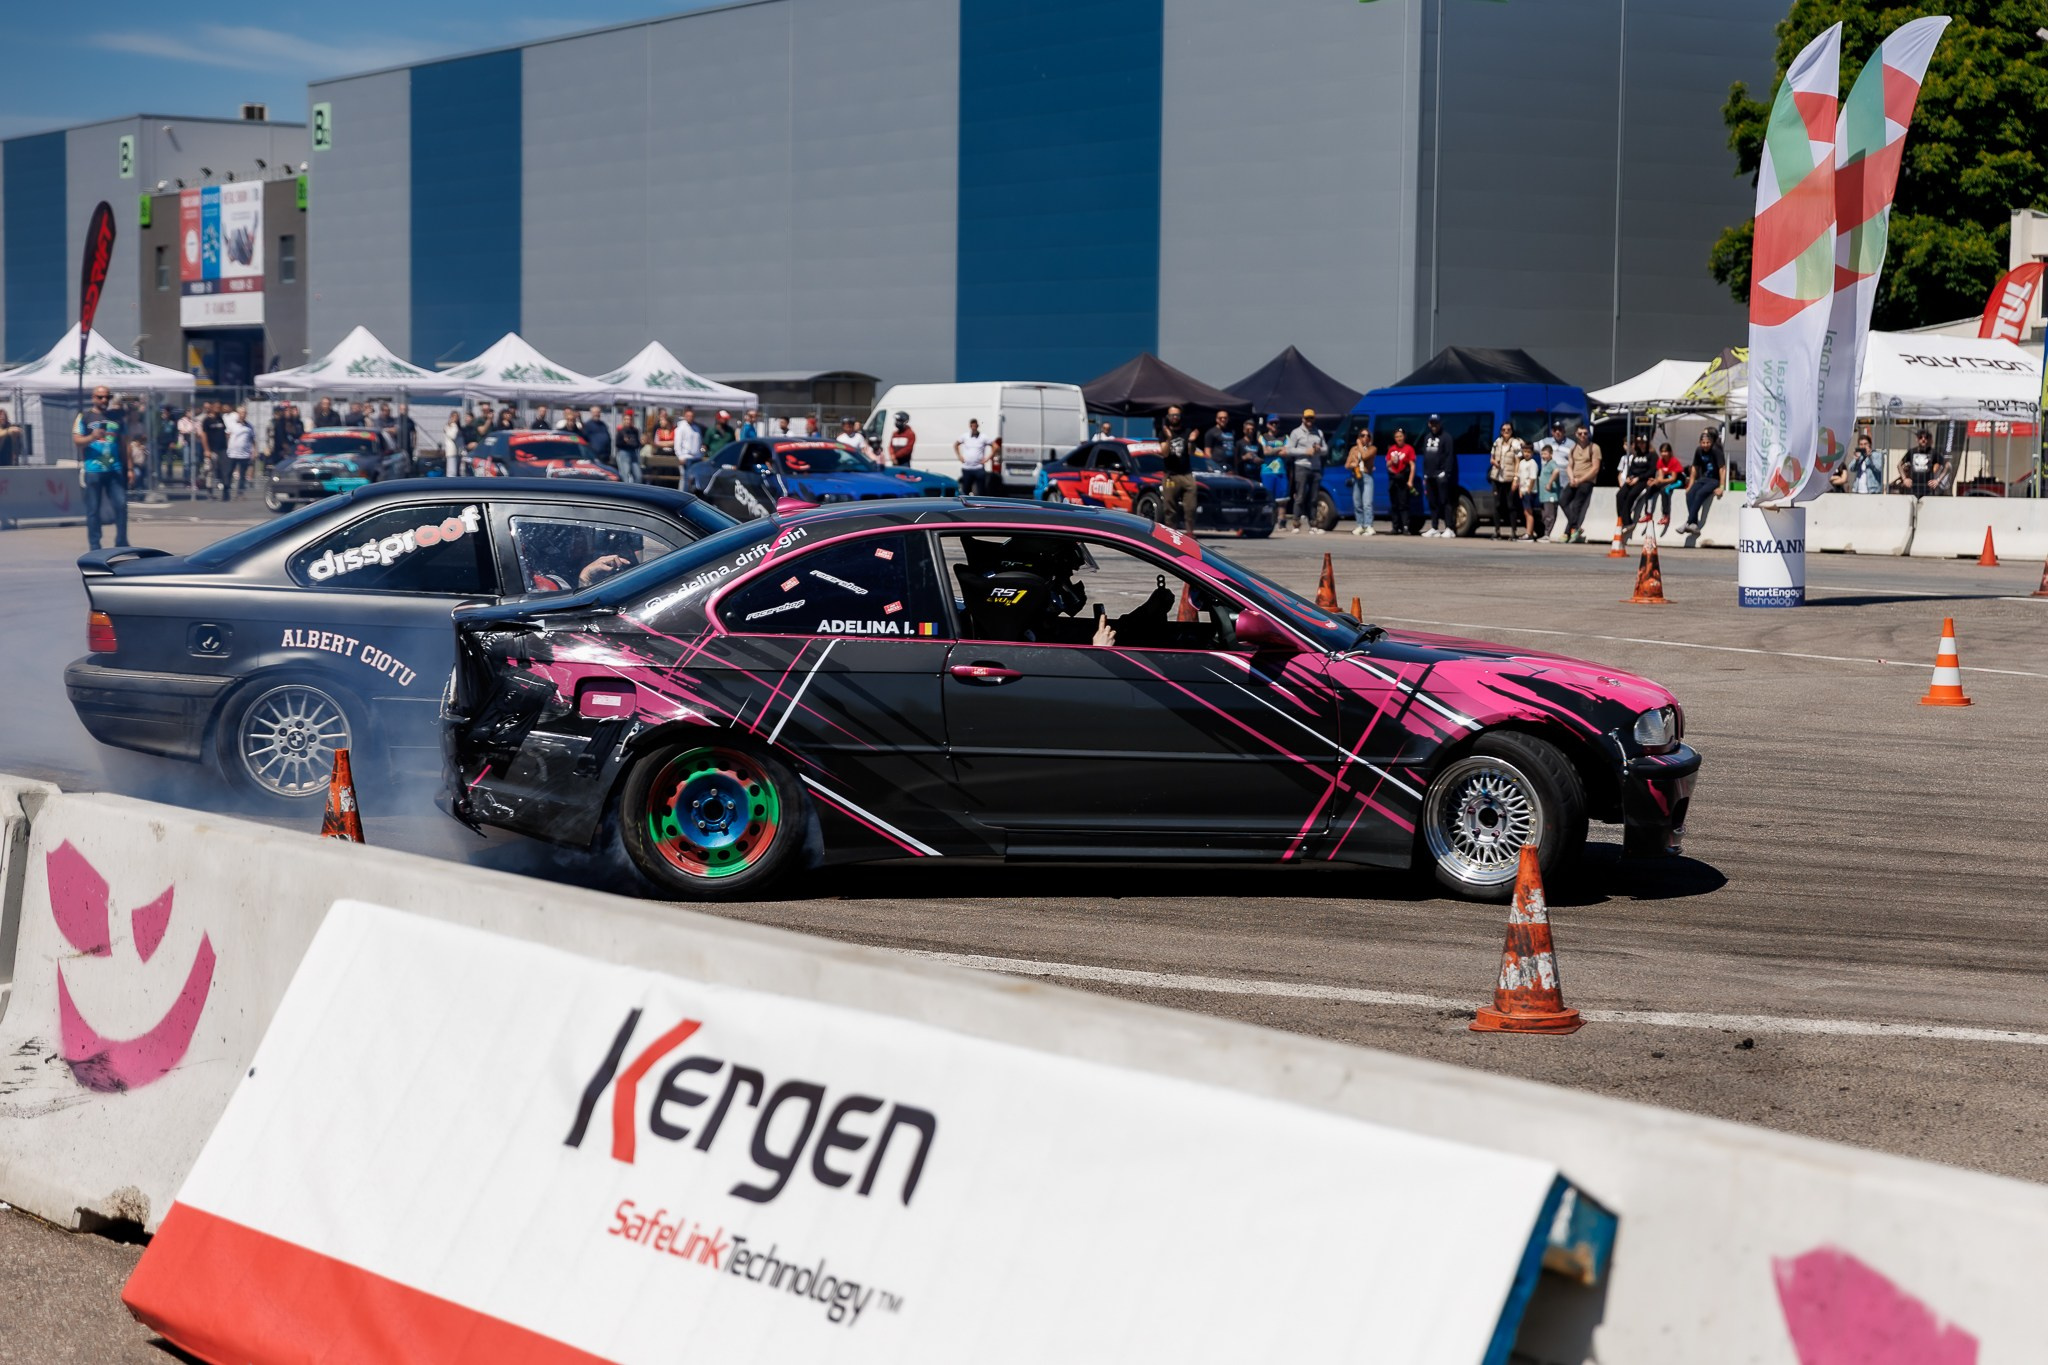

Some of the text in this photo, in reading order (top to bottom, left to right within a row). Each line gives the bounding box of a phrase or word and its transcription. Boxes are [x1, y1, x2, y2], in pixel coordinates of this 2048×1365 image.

[1898, 353, 2035, 373] POLYTRON
[307, 504, 482, 582] dissproof
[1744, 597, 1796, 607] technology
[816, 619, 900, 634] ADELINA
[281, 628, 417, 687] ALBERT CIOTU
[563, 1007, 937, 1207] Kergen
